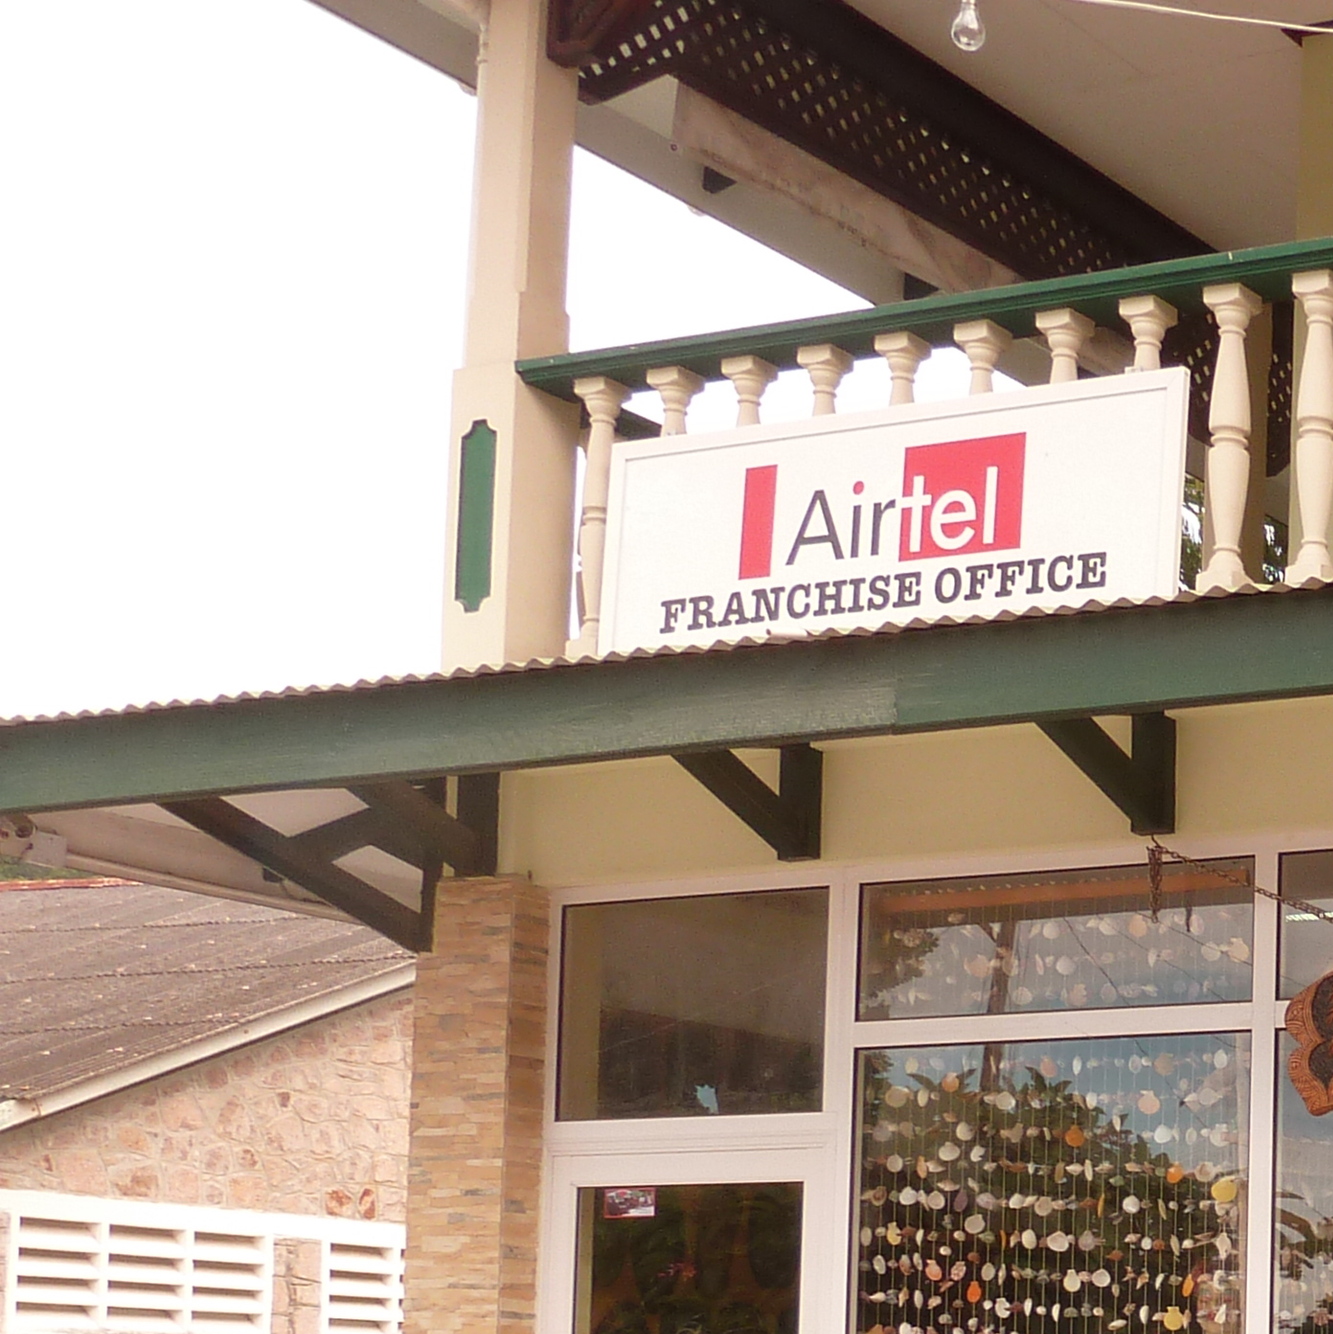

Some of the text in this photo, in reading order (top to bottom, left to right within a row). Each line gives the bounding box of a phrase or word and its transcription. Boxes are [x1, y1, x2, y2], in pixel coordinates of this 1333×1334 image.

[786, 465, 997, 566] Airtel
[659, 551, 1107, 634] FRANCHISE OFFICE
